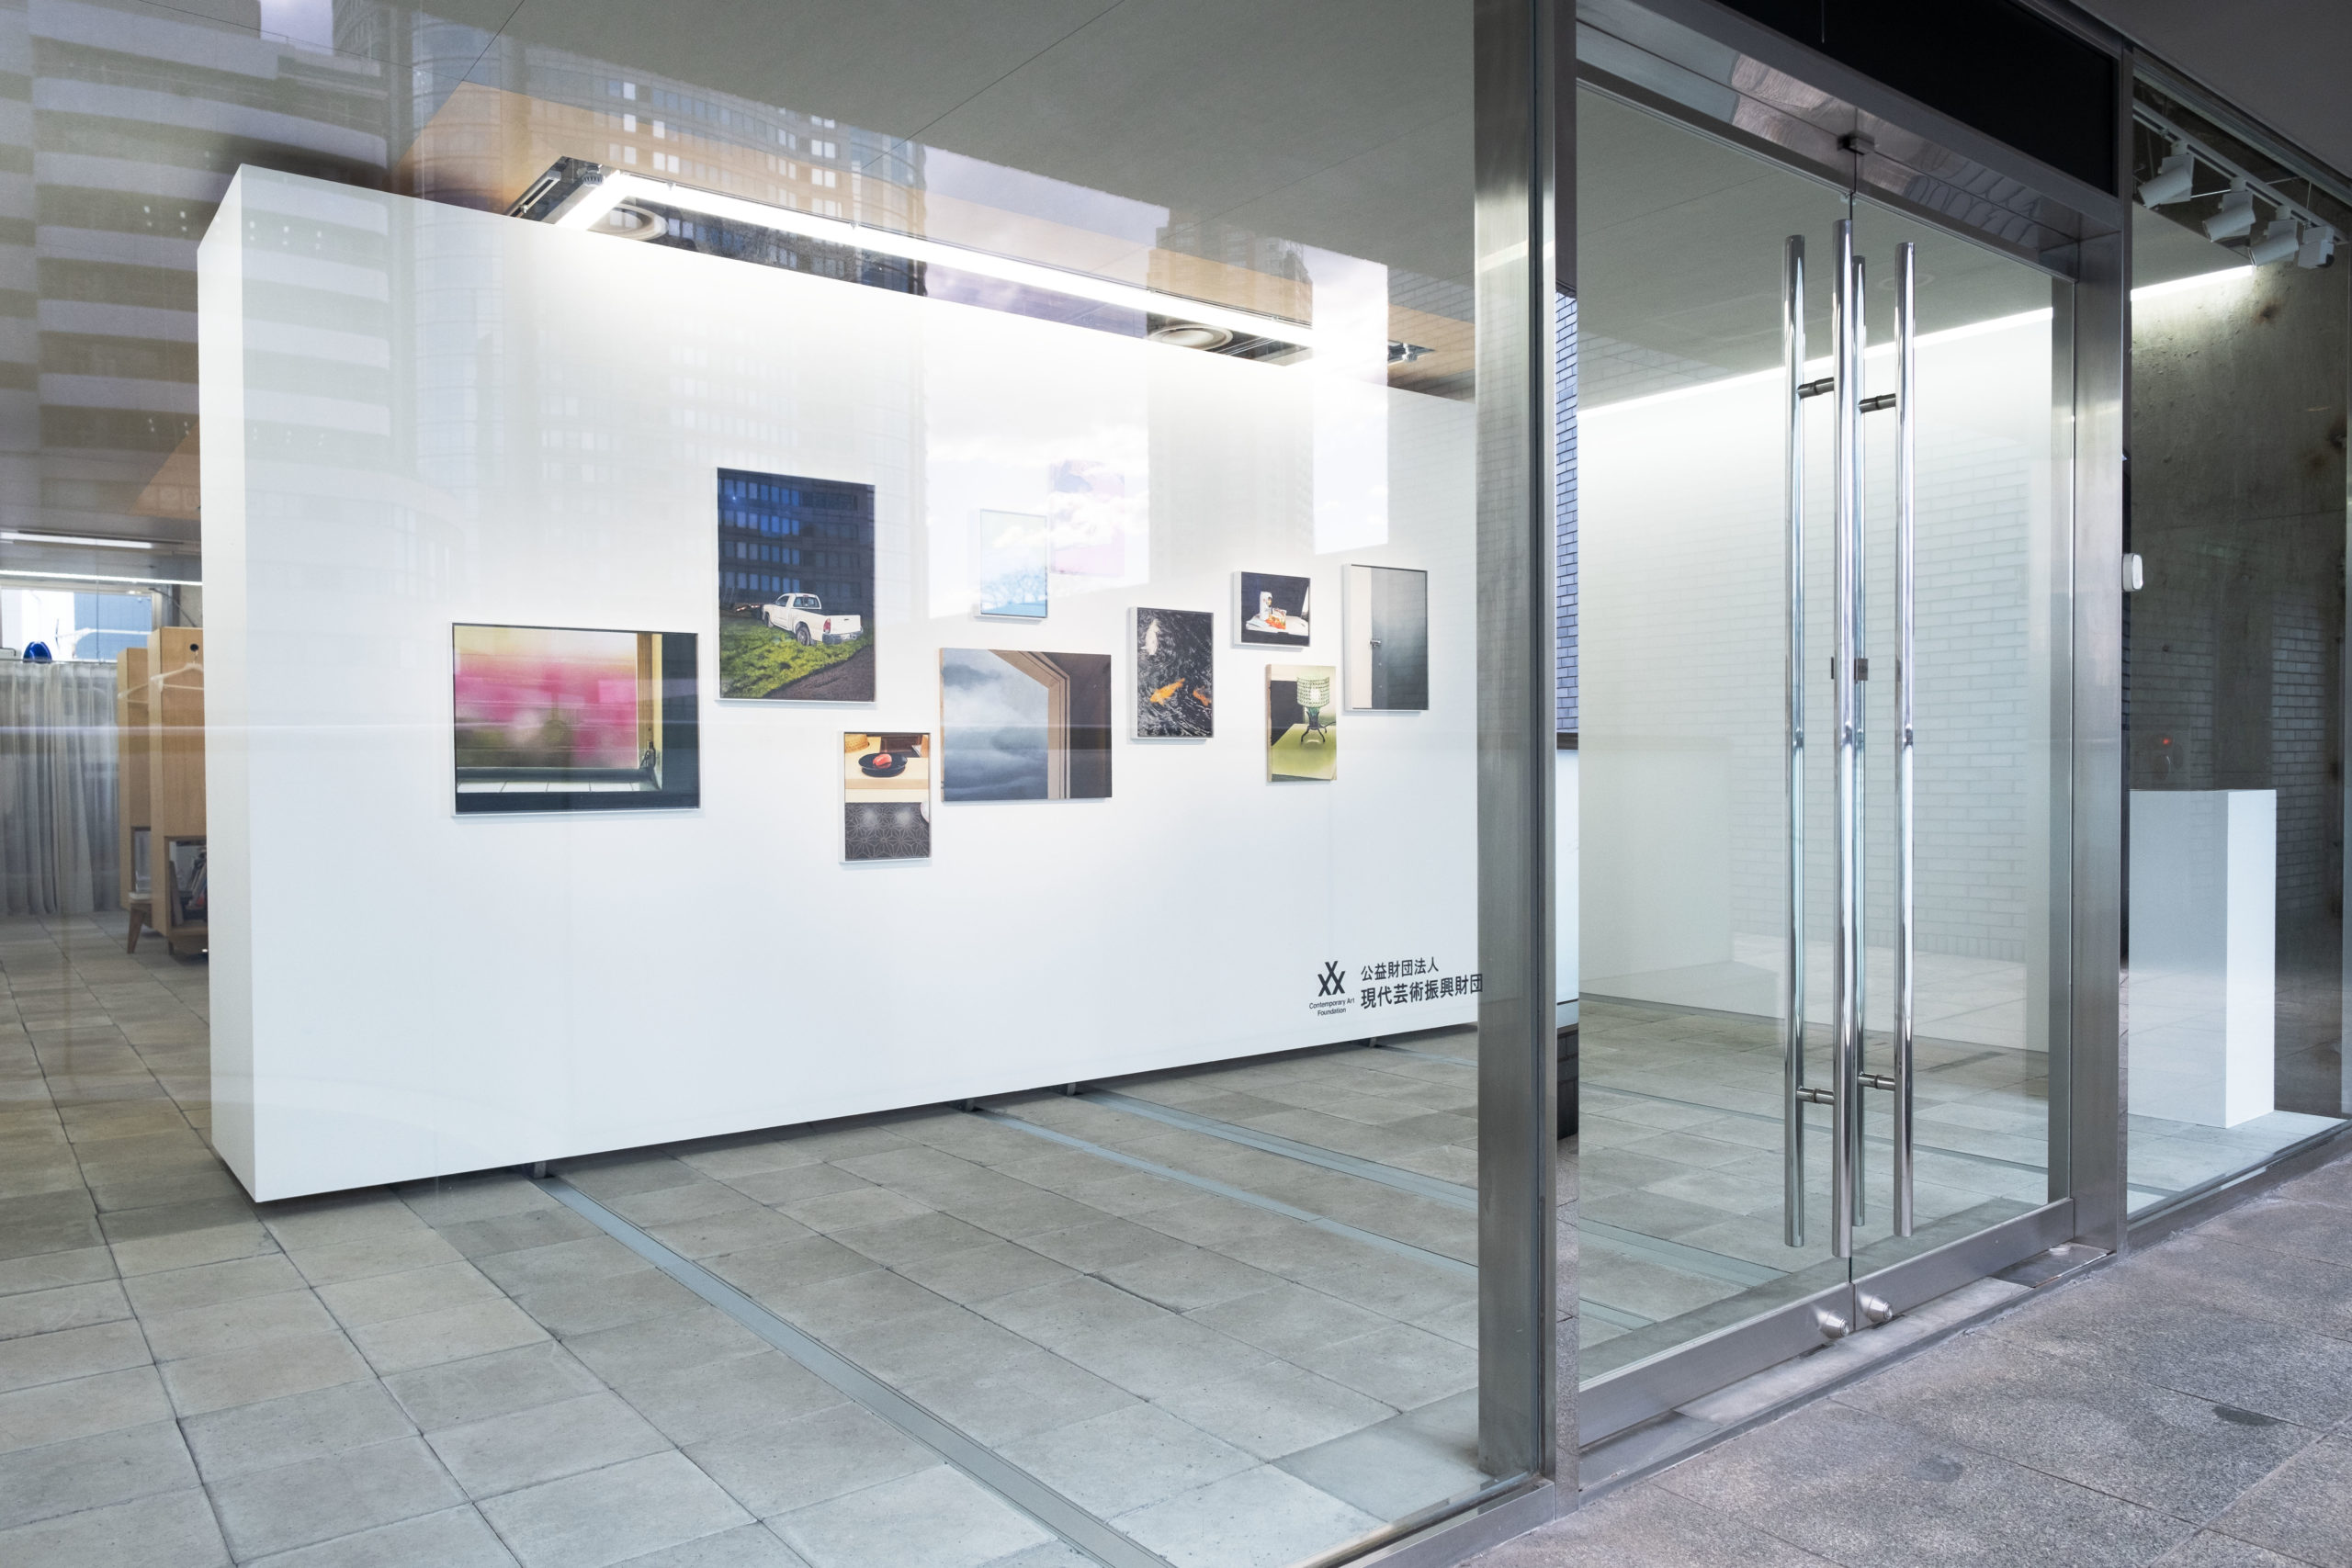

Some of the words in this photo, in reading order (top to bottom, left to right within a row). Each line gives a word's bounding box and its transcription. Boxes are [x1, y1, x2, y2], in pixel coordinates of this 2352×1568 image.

[1361, 956, 1439, 981] 公益財団法人
[1361, 974, 1483, 1009] 現代芸術振興財団
[1309, 999, 1346, 1010] Contemporary
[1317, 1008, 1346, 1016] Foundation
